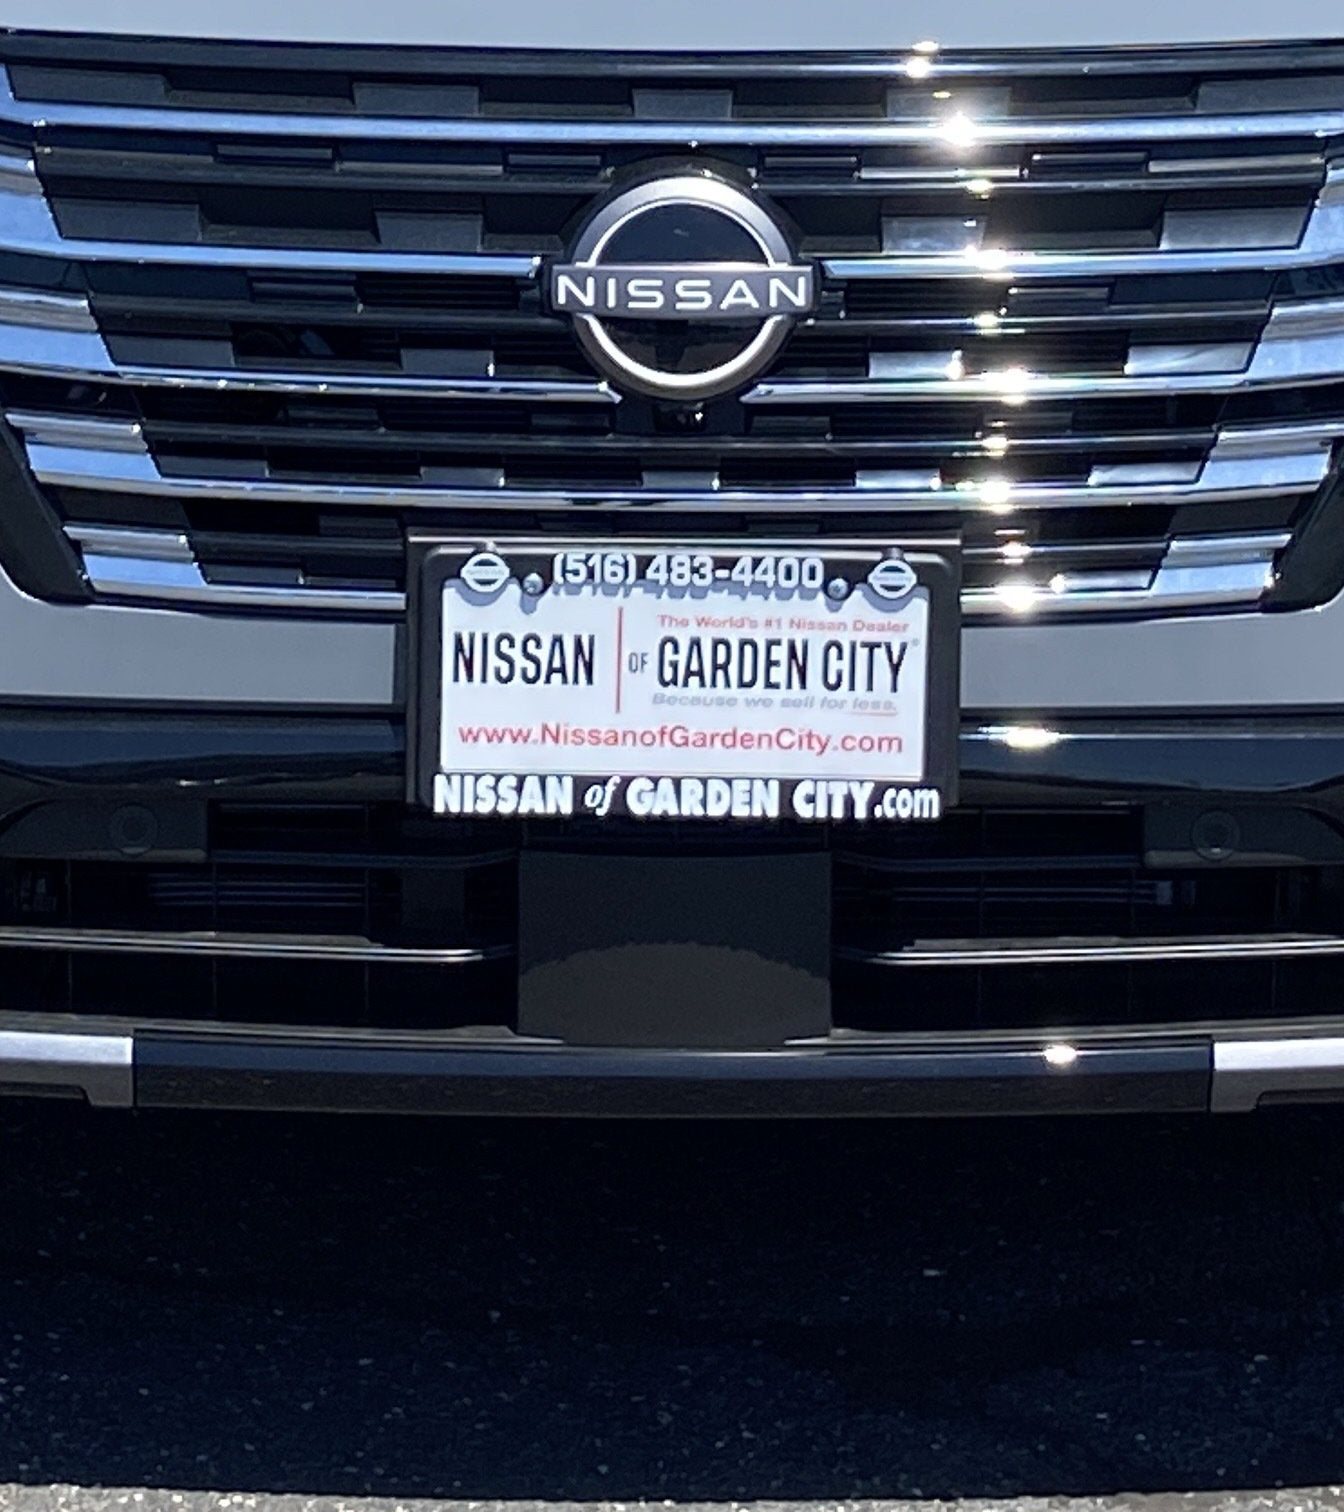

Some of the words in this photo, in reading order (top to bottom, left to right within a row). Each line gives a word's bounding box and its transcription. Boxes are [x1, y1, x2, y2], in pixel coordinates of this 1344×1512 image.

[557, 275, 806, 310] NISSAN
[554, 553, 636, 585] (516)
[646, 554, 824, 588] 483-4400
[657, 615, 689, 628] The
[695, 616, 759, 630] World's
[764, 617, 782, 630] #1
[789, 618, 848, 631] Nissan
[853, 619, 910, 633] Dealer
[453, 632, 595, 685] NISSAN
[628, 652, 649, 674] OF
[658, 636, 809, 690] GARDEN
[822, 639, 907, 693] CITY
[652, 692, 737, 708] Because
[745, 697, 774, 709] we
[780, 695, 814, 709] sell
[820, 696, 847, 710] for
[458, 723, 903, 756] www.NissanofGardenCity.com
[433, 774, 574, 814] NISSAN
[584, 775, 621, 817] of
[625, 776, 780, 817] GARDEN
[792, 779, 941, 819] CITY.com
